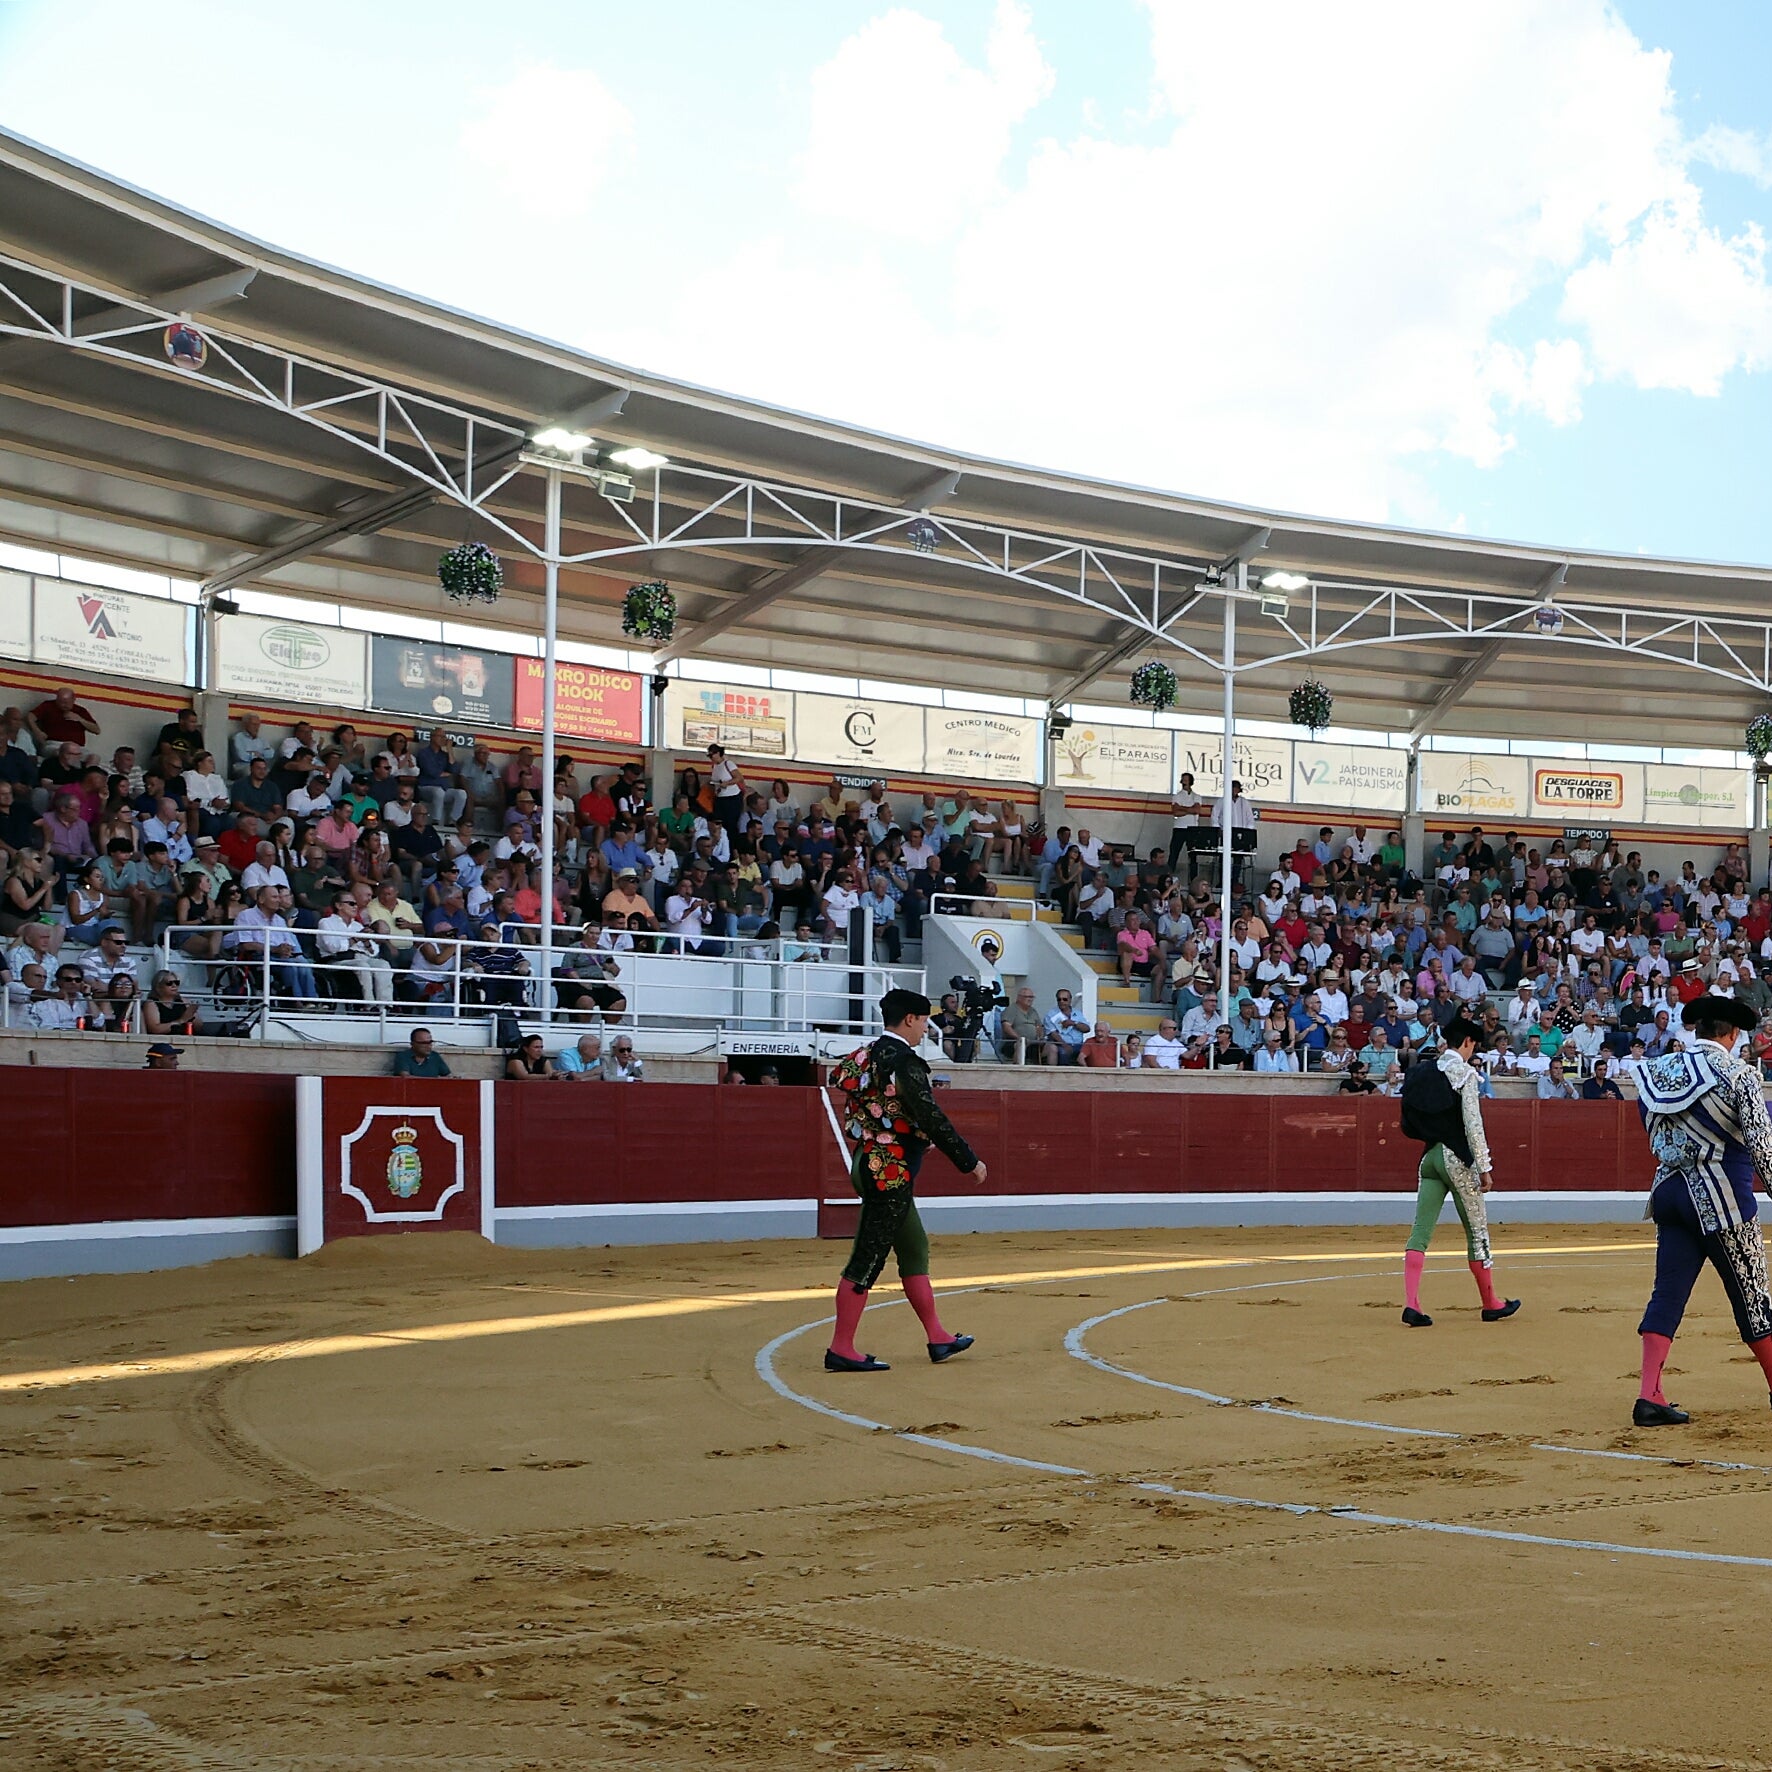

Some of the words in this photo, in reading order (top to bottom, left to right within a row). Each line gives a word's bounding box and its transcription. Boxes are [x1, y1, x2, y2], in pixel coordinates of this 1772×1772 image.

[588, 672, 633, 692] DISCO
[557, 684, 604, 703] HOOK
[945, 719, 982, 731] CENTRO
[984, 720, 1021, 737] MEDICO
[416, 729, 466, 746] TEIDO
[466, 737, 475, 747] 2
[984, 751, 992, 759] de
[994, 753, 1021, 762] Lourdes
[1100, 747, 1115, 757] EL
[1339, 764, 1405, 778] JARDINERÍA
[1211, 776, 1256, 794] Jago
[1339, 776, 1404, 791] PAISAJISMO
[1545, 777, 1612, 788] DESGUACES
[1437, 793, 1516, 809] BIOPLAGAS
[1544, 786, 1562, 798] LA
[1567, 786, 1614, 801] TORRE
[1604, 830, 1610, 840] 1
[732, 1043, 801, 1054] ENFERMERÍA
